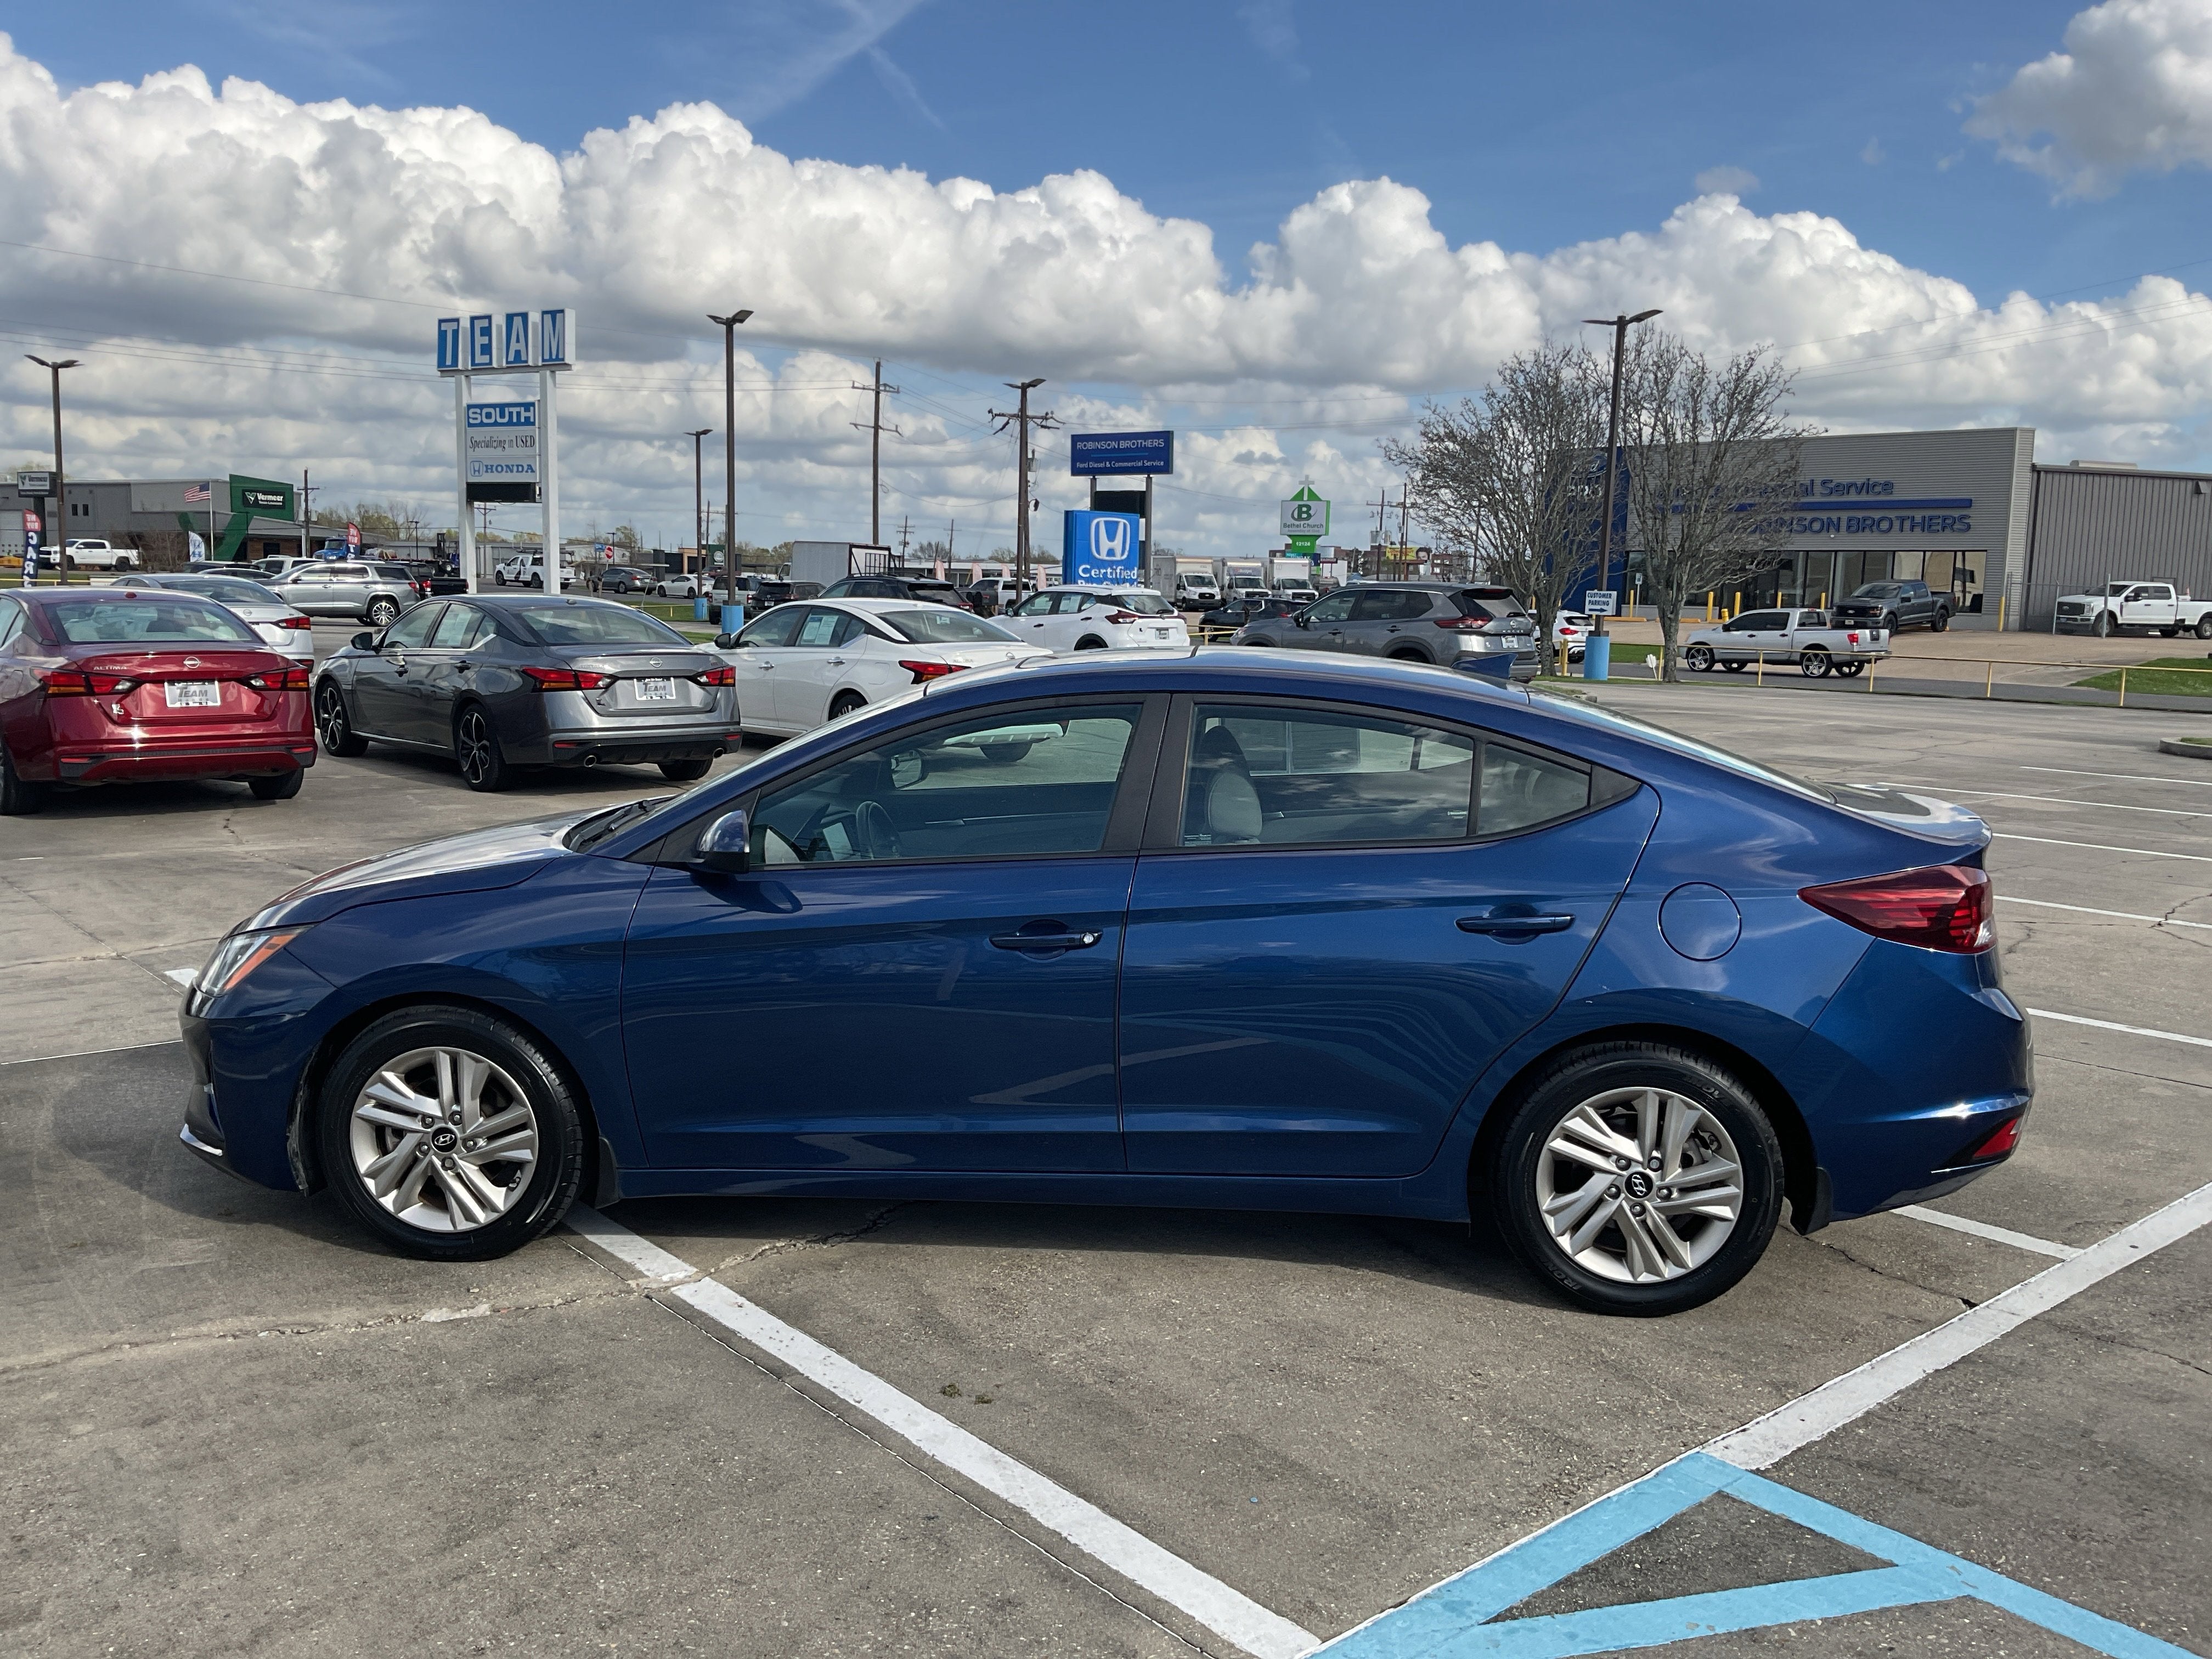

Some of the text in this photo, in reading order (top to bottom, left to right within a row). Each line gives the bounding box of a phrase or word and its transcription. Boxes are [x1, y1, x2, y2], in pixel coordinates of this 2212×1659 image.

[441, 313, 564, 365] TEAM
[469, 407, 534, 424] SOUTH
[470, 435, 535, 452] Specializing in USED
[1077, 439, 1165, 450] ROBINSON BROTHERS
[484, 464, 535, 473] HONDA
[1820, 478, 1894, 496] Service
[257, 493, 284, 501] Vermeer
[1846, 514, 1971, 533] BROTHERS
[1078, 565, 1137, 579] Certified
